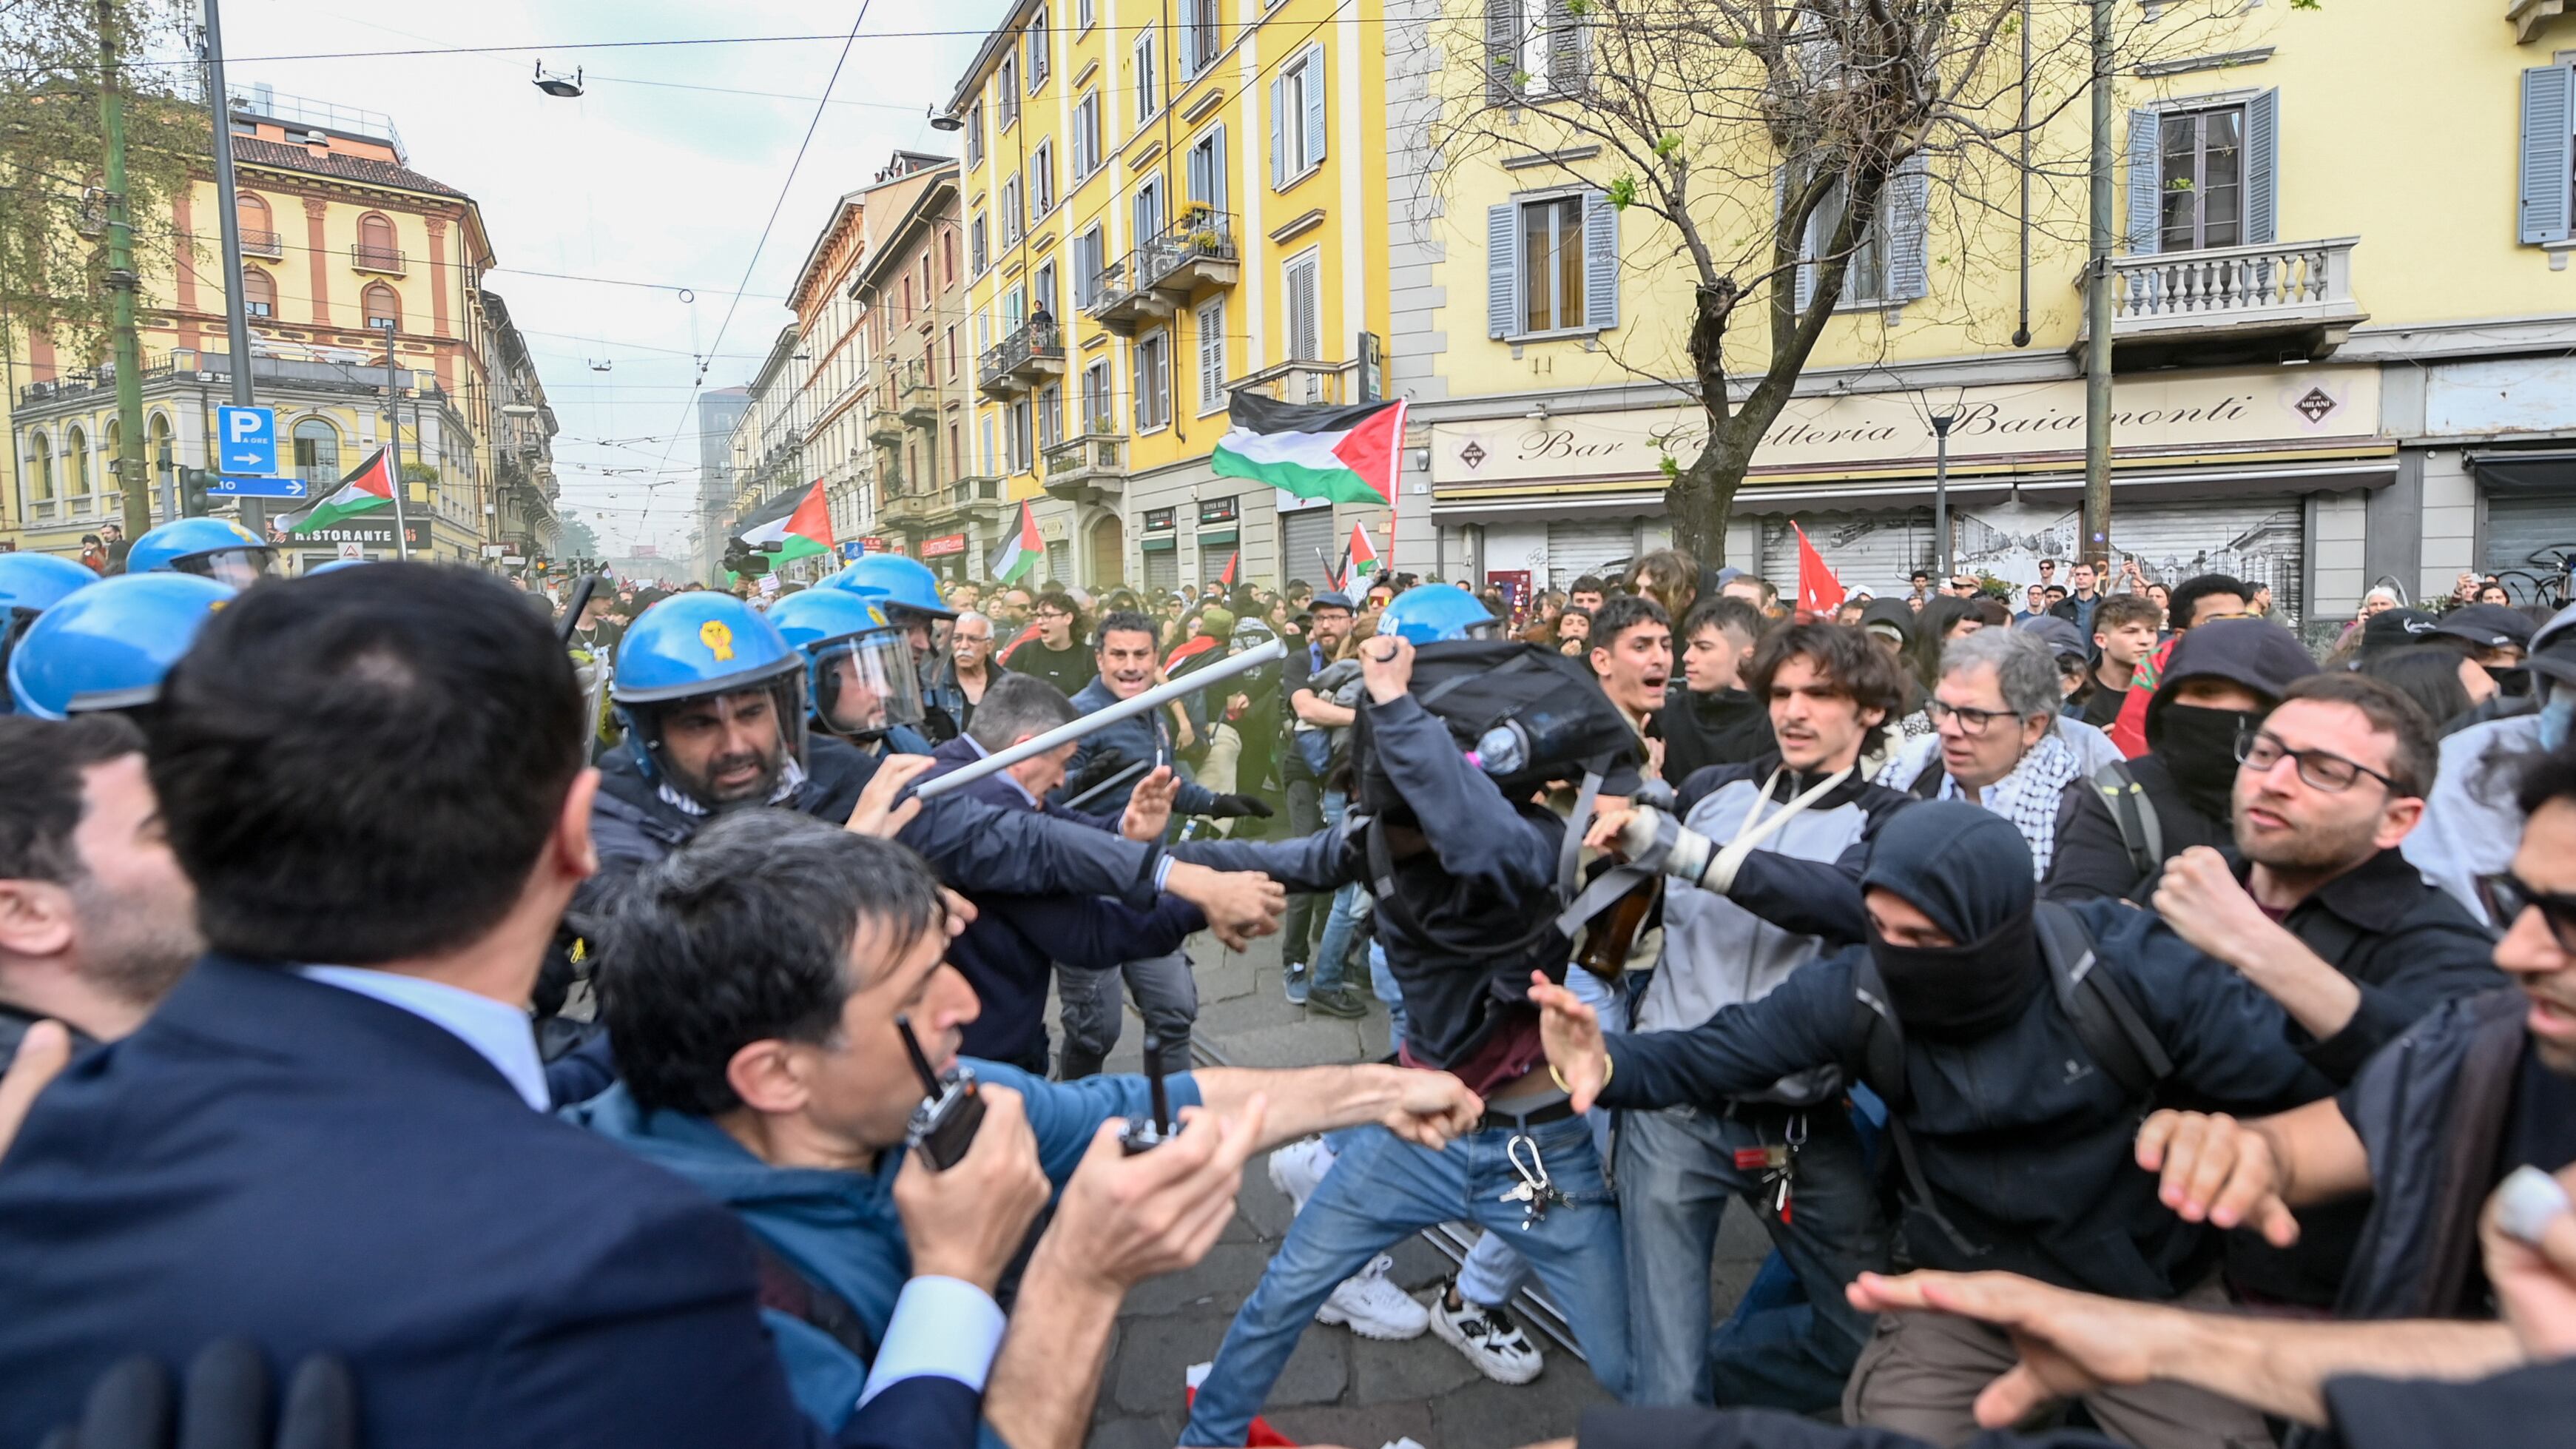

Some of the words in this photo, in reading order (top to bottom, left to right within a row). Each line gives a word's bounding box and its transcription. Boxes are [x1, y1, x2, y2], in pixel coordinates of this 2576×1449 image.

[2301, 400, 2330, 409] MILANI
[229, 411, 262, 443] P
[1517, 429, 1625, 460] Bar
[1648, 420, 1899, 455] Cetteria
[294, 530, 392, 541] RISTORANTE
